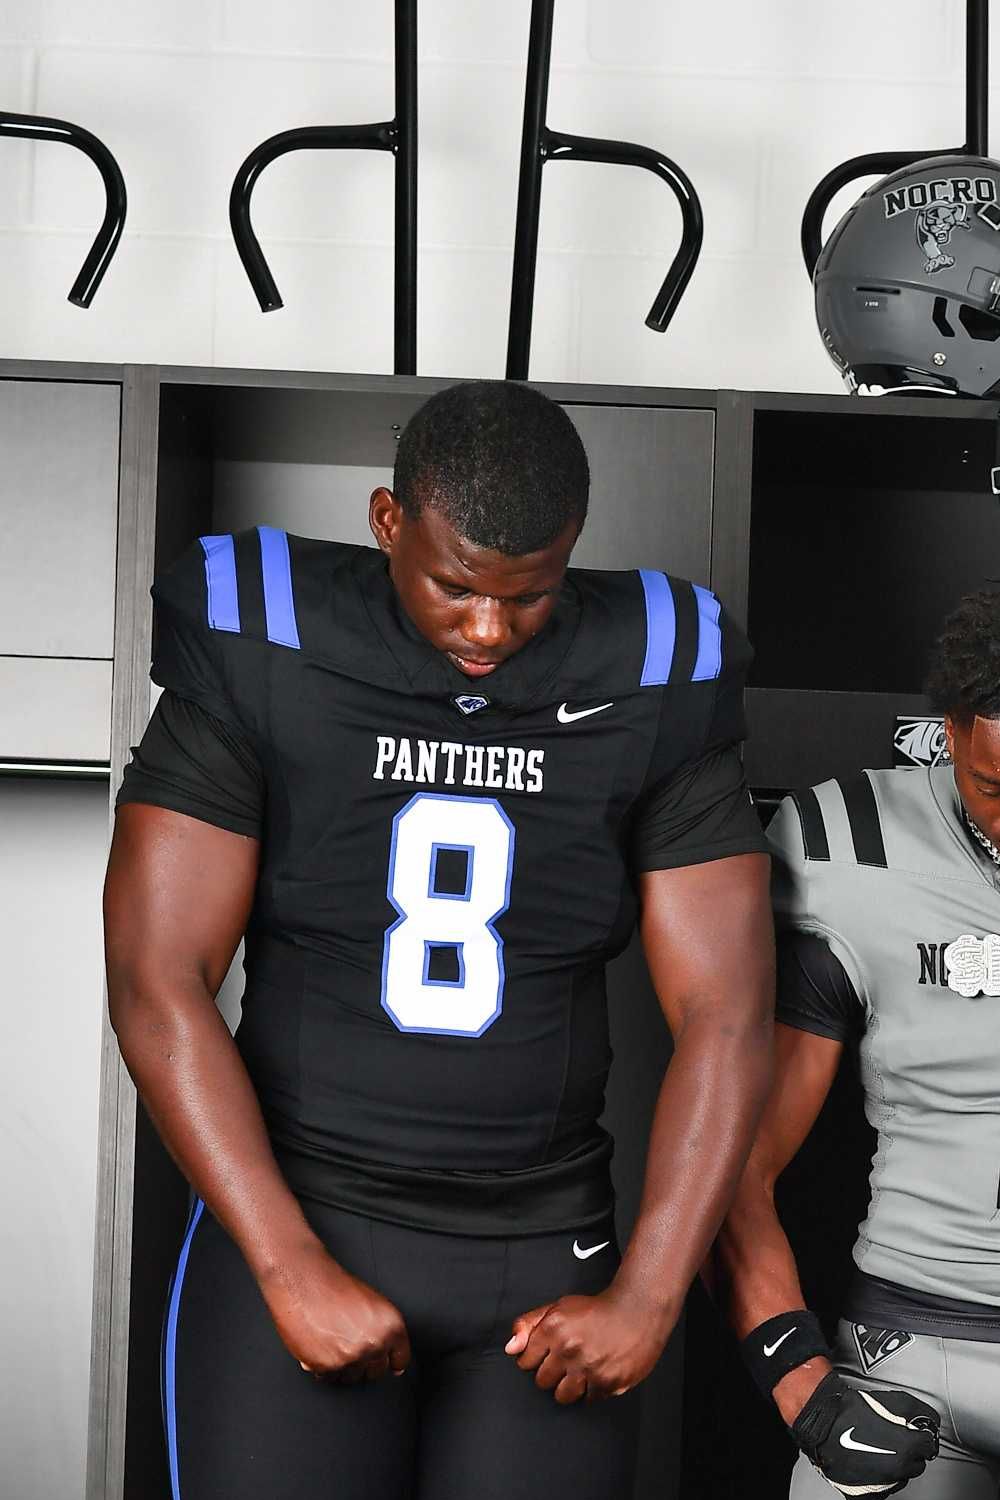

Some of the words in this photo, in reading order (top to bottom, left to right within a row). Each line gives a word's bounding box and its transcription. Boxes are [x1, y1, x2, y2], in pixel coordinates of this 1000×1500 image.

[884, 177, 998, 218] NOCRO
[373, 736, 545, 793] PANTHERS
[380, 791, 516, 1038] 8
